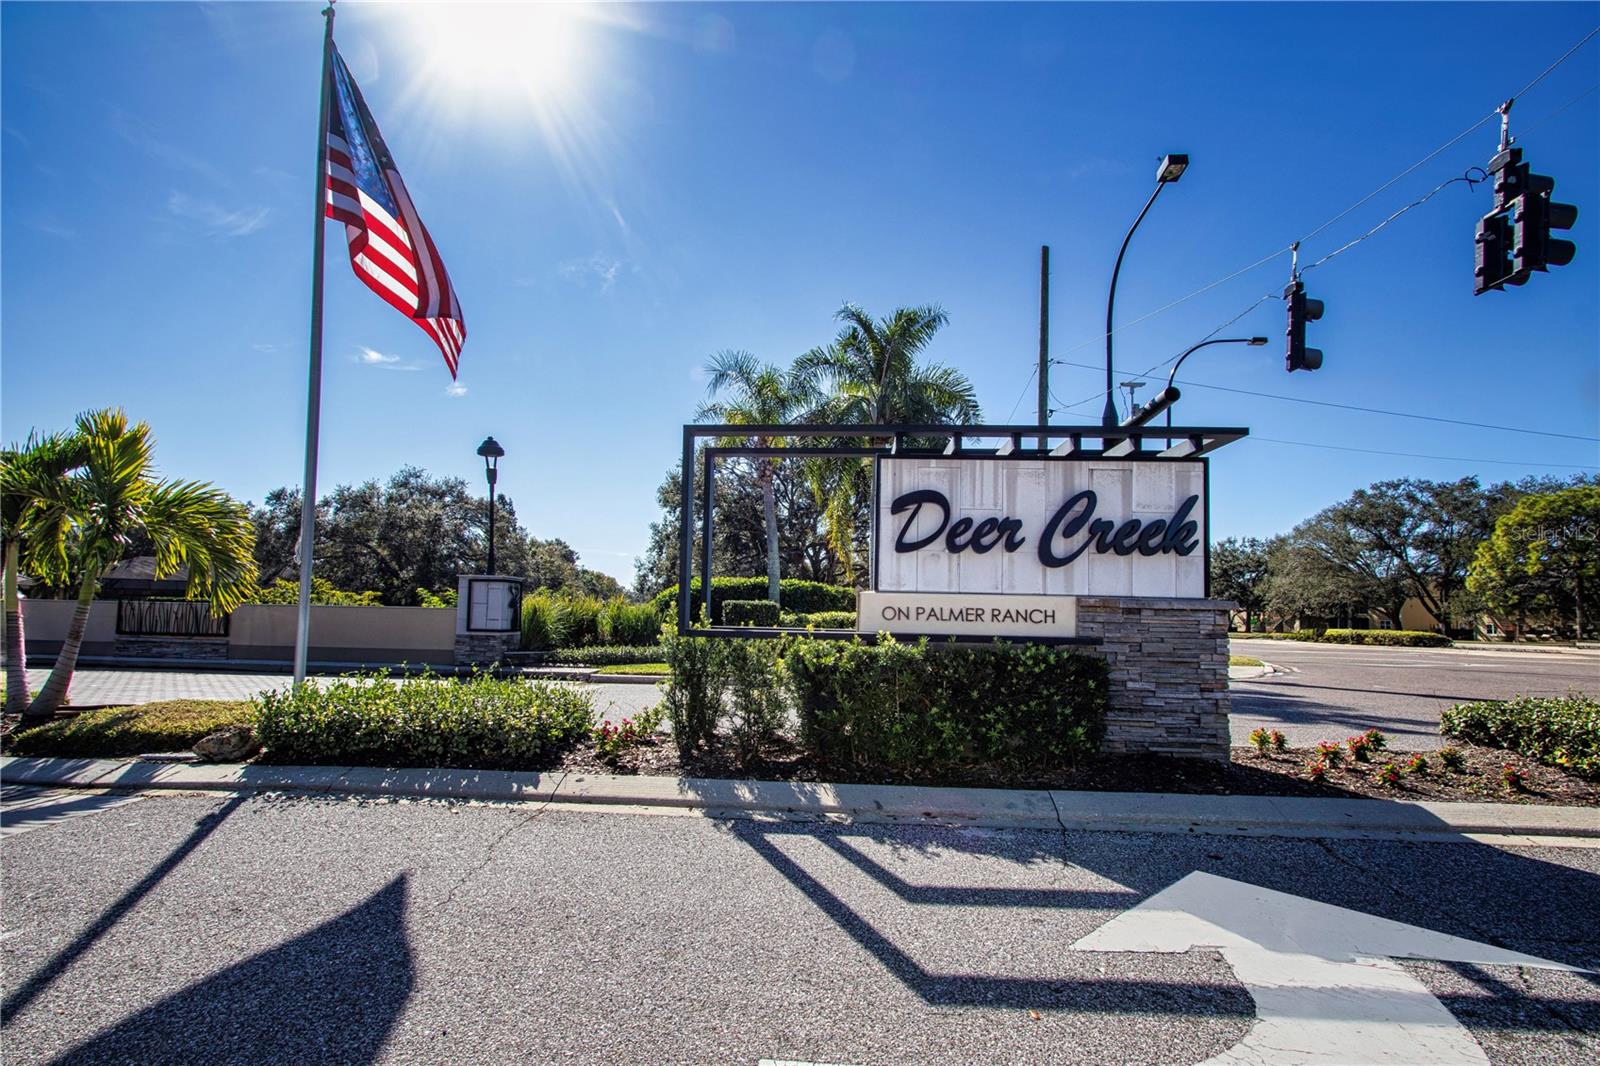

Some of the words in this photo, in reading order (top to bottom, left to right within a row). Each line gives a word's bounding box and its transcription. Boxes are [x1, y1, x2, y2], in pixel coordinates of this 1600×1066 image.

[890, 489, 1025, 554] Deer
[1037, 489, 1200, 568] Creek
[881, 605, 910, 621] ON
[915, 606, 985, 623] PALMER
[990, 608, 1057, 624] RANCH
